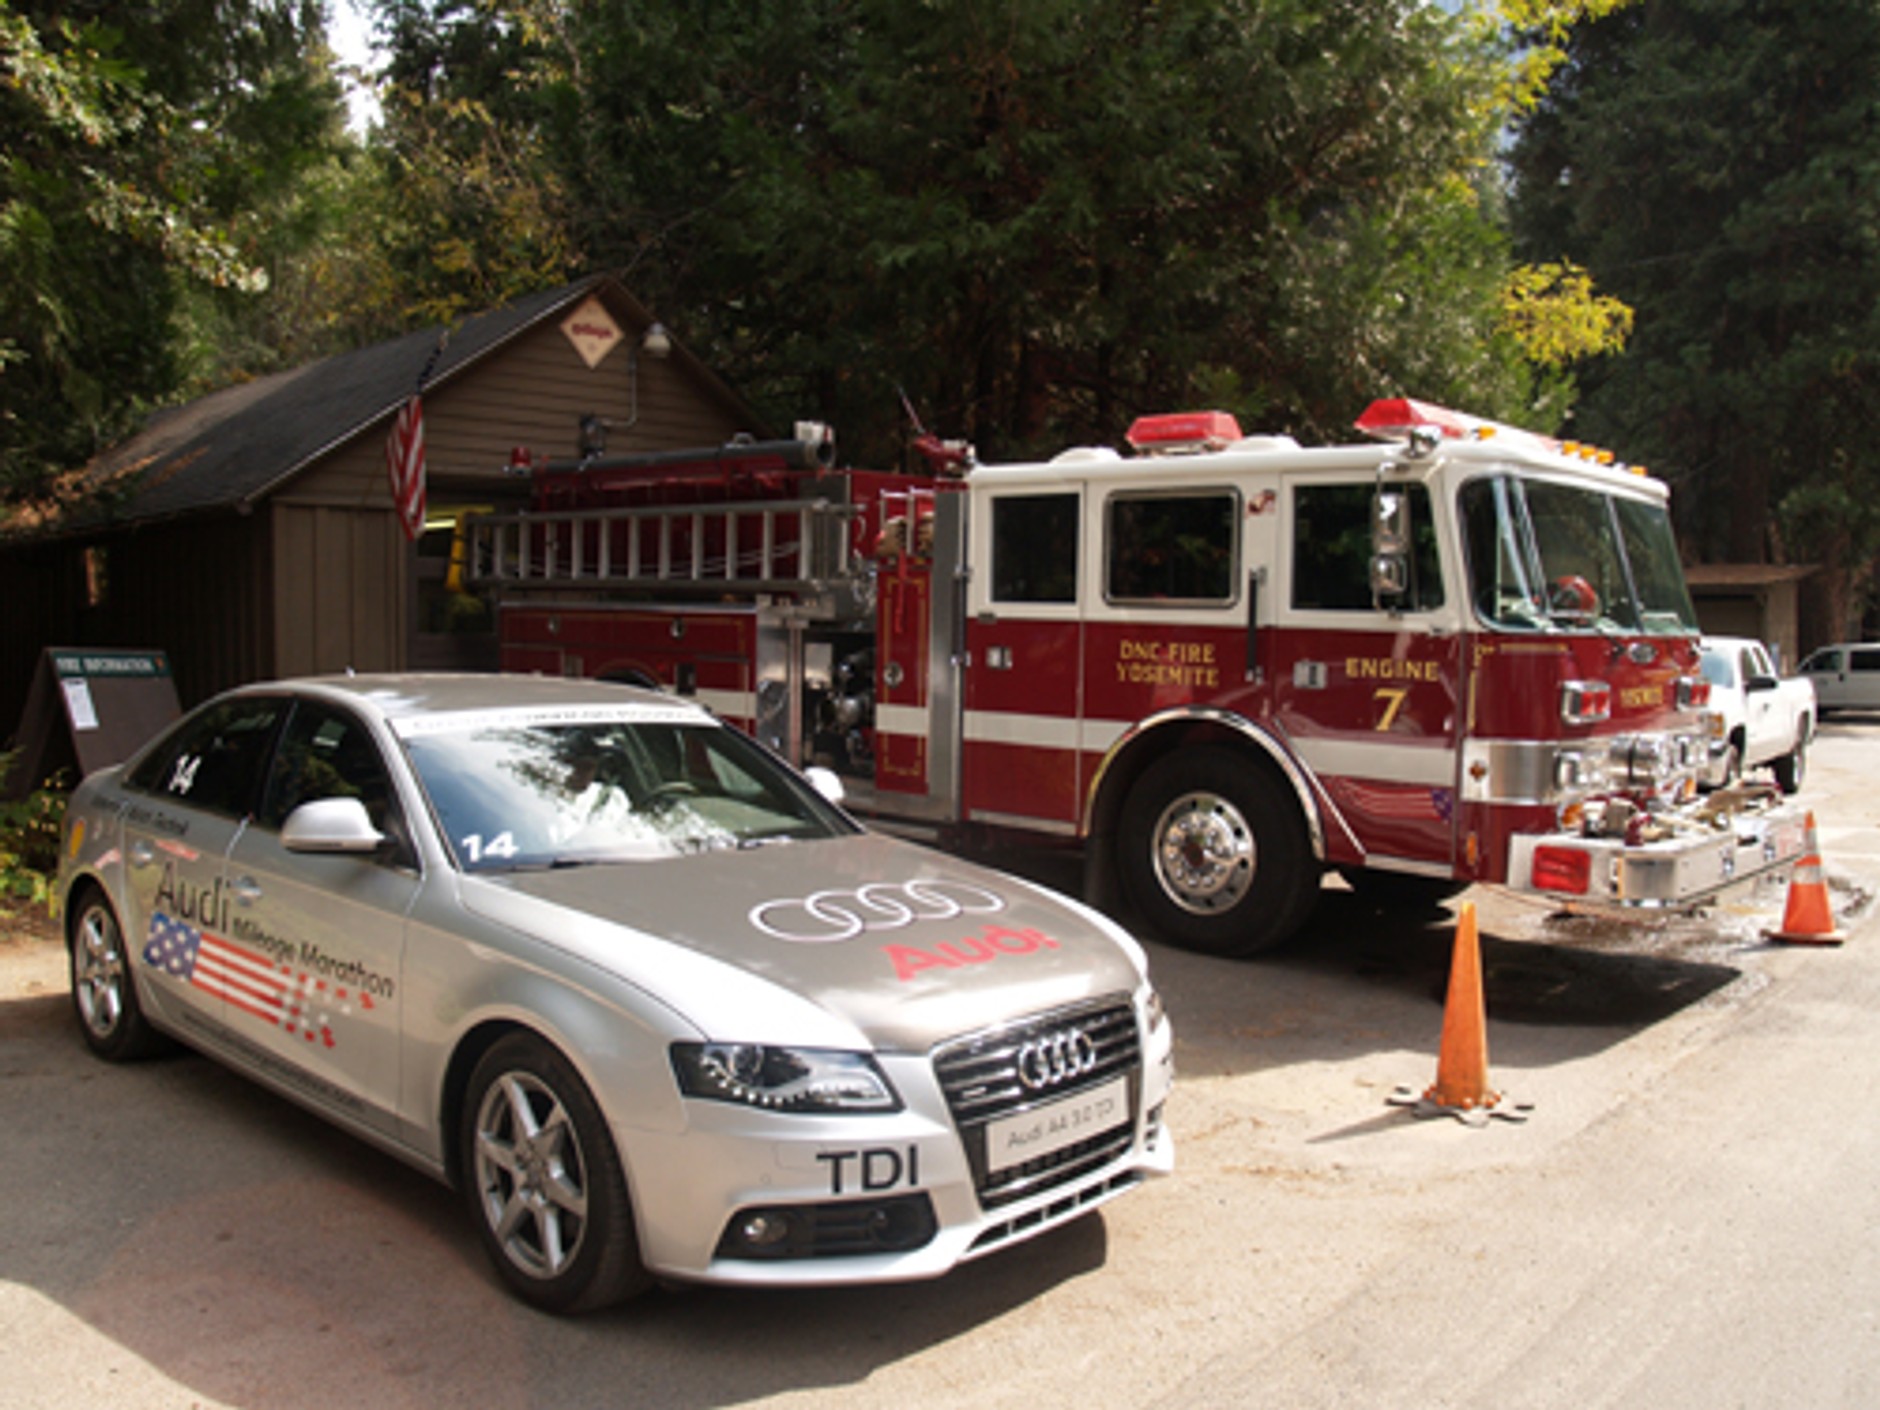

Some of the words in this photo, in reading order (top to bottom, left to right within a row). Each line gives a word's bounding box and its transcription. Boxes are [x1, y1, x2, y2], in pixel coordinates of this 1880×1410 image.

[1120, 640, 1160, 660] DNC
[1168, 643, 1216, 664] FIRE
[1346, 658, 1439, 681] ENGINE
[1116, 662, 1219, 687] YOSEMITE
[1374, 689, 1407, 731] 7
[168, 753, 201, 795] 14
[461, 832, 519, 863] 14
[155, 861, 232, 933] Audi
[232, 916, 296, 964] Mileage
[298, 940, 395, 999] Marathon
[883, 924, 1061, 982] Audi
[1006, 1120, 1043, 1149] Audi
[816, 1145, 920, 1195] TDI
